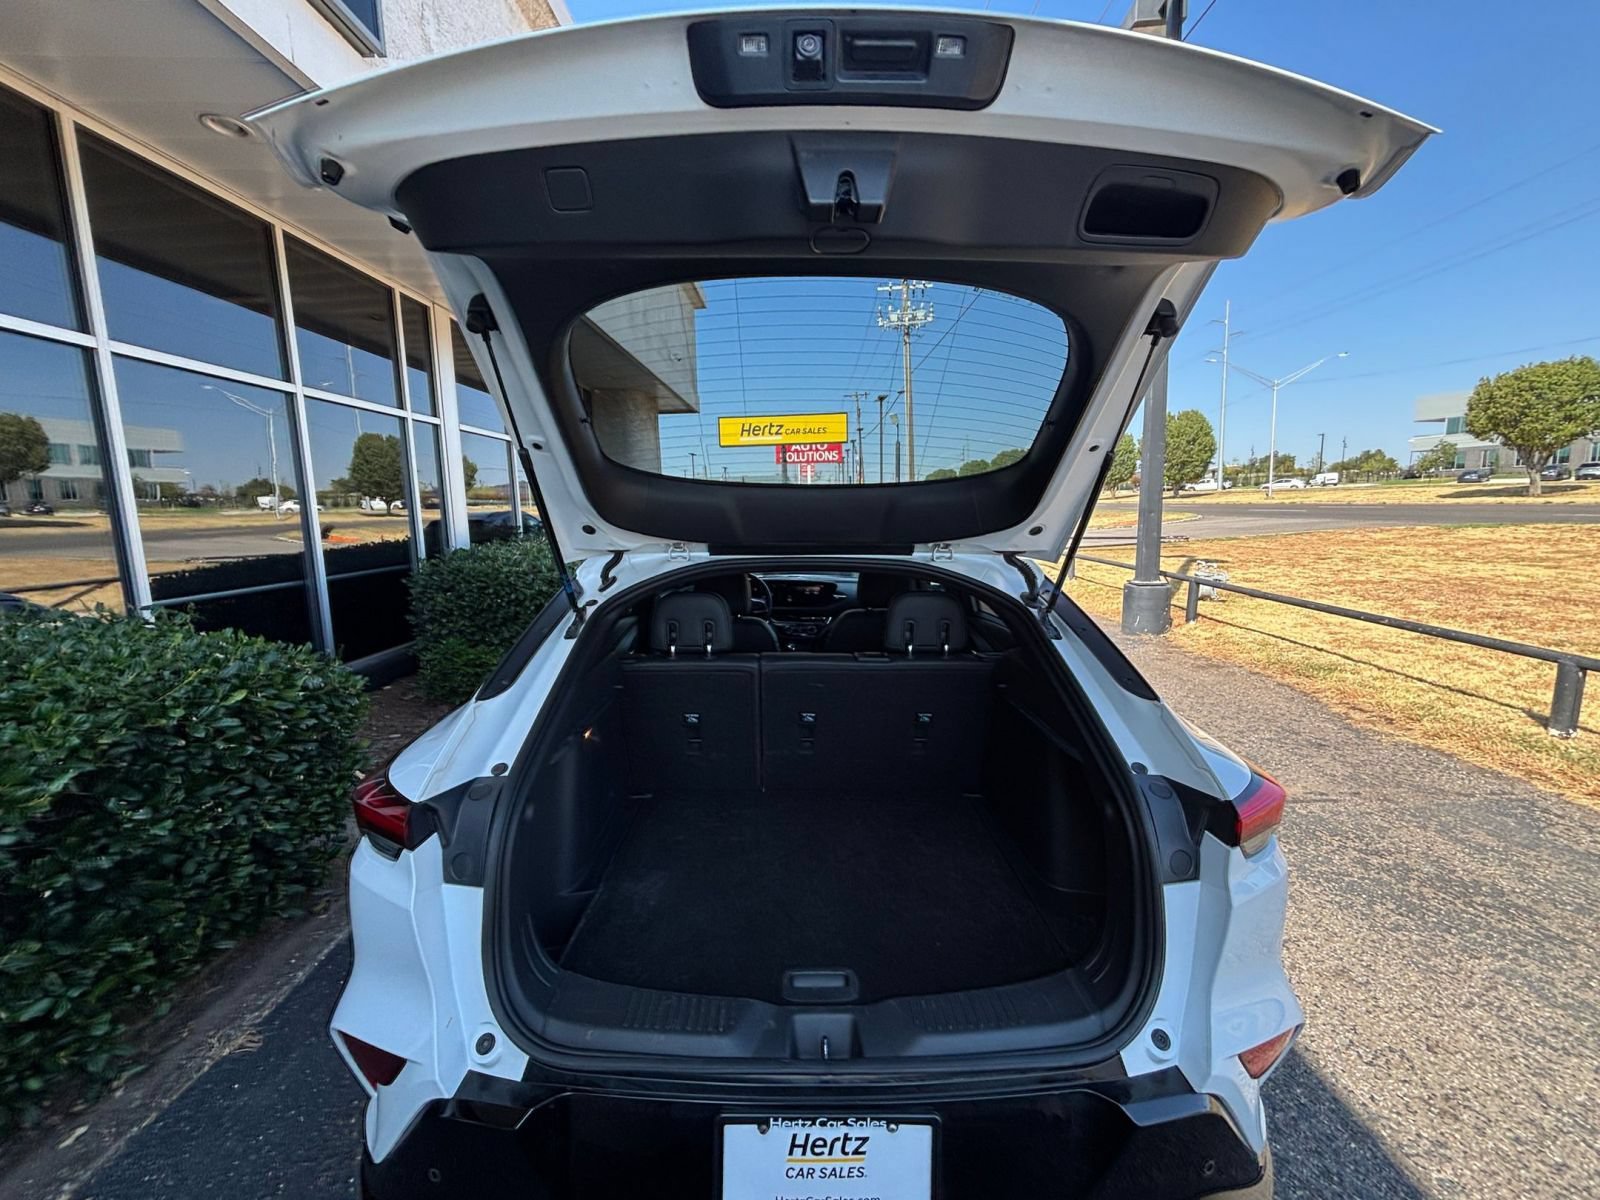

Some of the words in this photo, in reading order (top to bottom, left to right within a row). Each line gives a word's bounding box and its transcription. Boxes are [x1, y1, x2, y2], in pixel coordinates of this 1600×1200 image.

[740, 422, 784, 437] Hertz
[785, 428, 801, 436] CAR
[802, 427, 827, 435] SALES
[780, 450, 839, 462] OLUTIONS
[769, 1117, 812, 1128] Hertz
[816, 1117, 844, 1128] Car
[846, 1117, 888, 1128] Sales
[787, 1132, 870, 1157] Hertz
[785, 1167, 816, 1180] CAR
